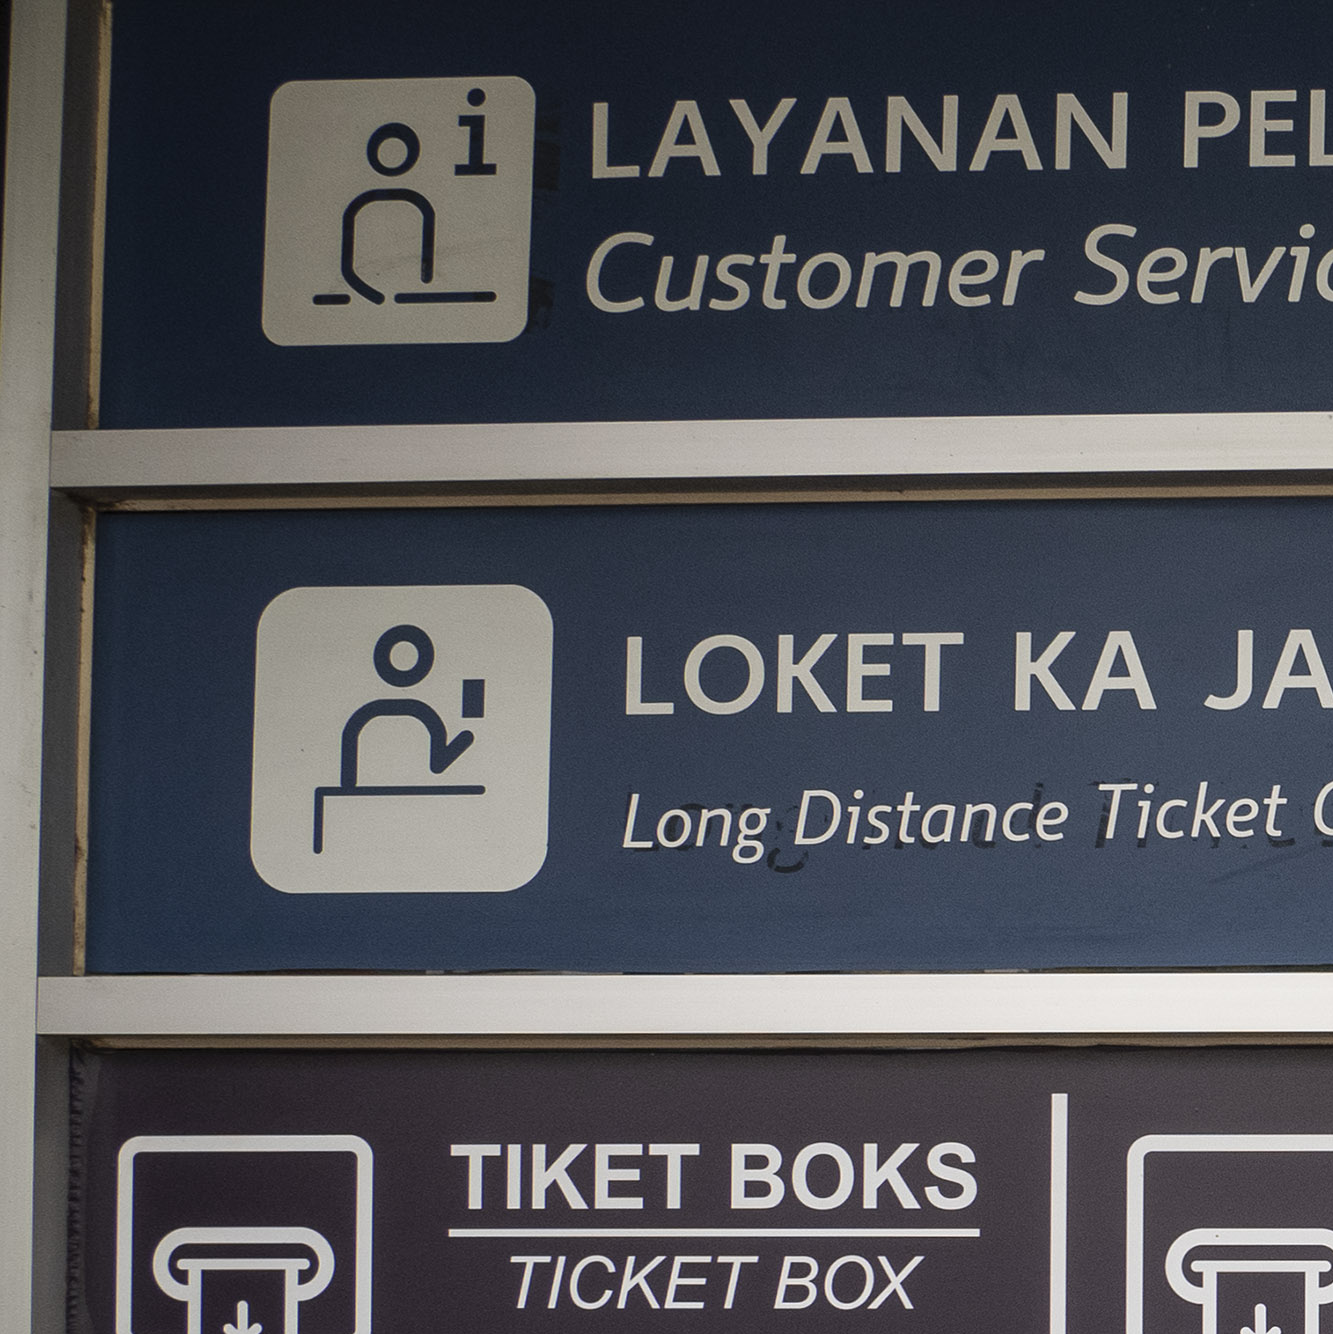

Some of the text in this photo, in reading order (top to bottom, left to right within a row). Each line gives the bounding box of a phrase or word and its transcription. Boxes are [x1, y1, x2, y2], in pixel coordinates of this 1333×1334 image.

[592, 91, 1129, 179] LAYANAN
[586, 231, 1046, 313] Customer
[625, 631, 965, 715] LOKET
[1014, 630, 1158, 712] KA
[622, 793, 772, 864] Long
[794, 789, 1069, 845] Distance
[1098, 780, 1288, 840] Ticket
[450, 1141, 978, 1211] TIKET BOKS
[510, 1254, 925, 1311] TICKET BOX
